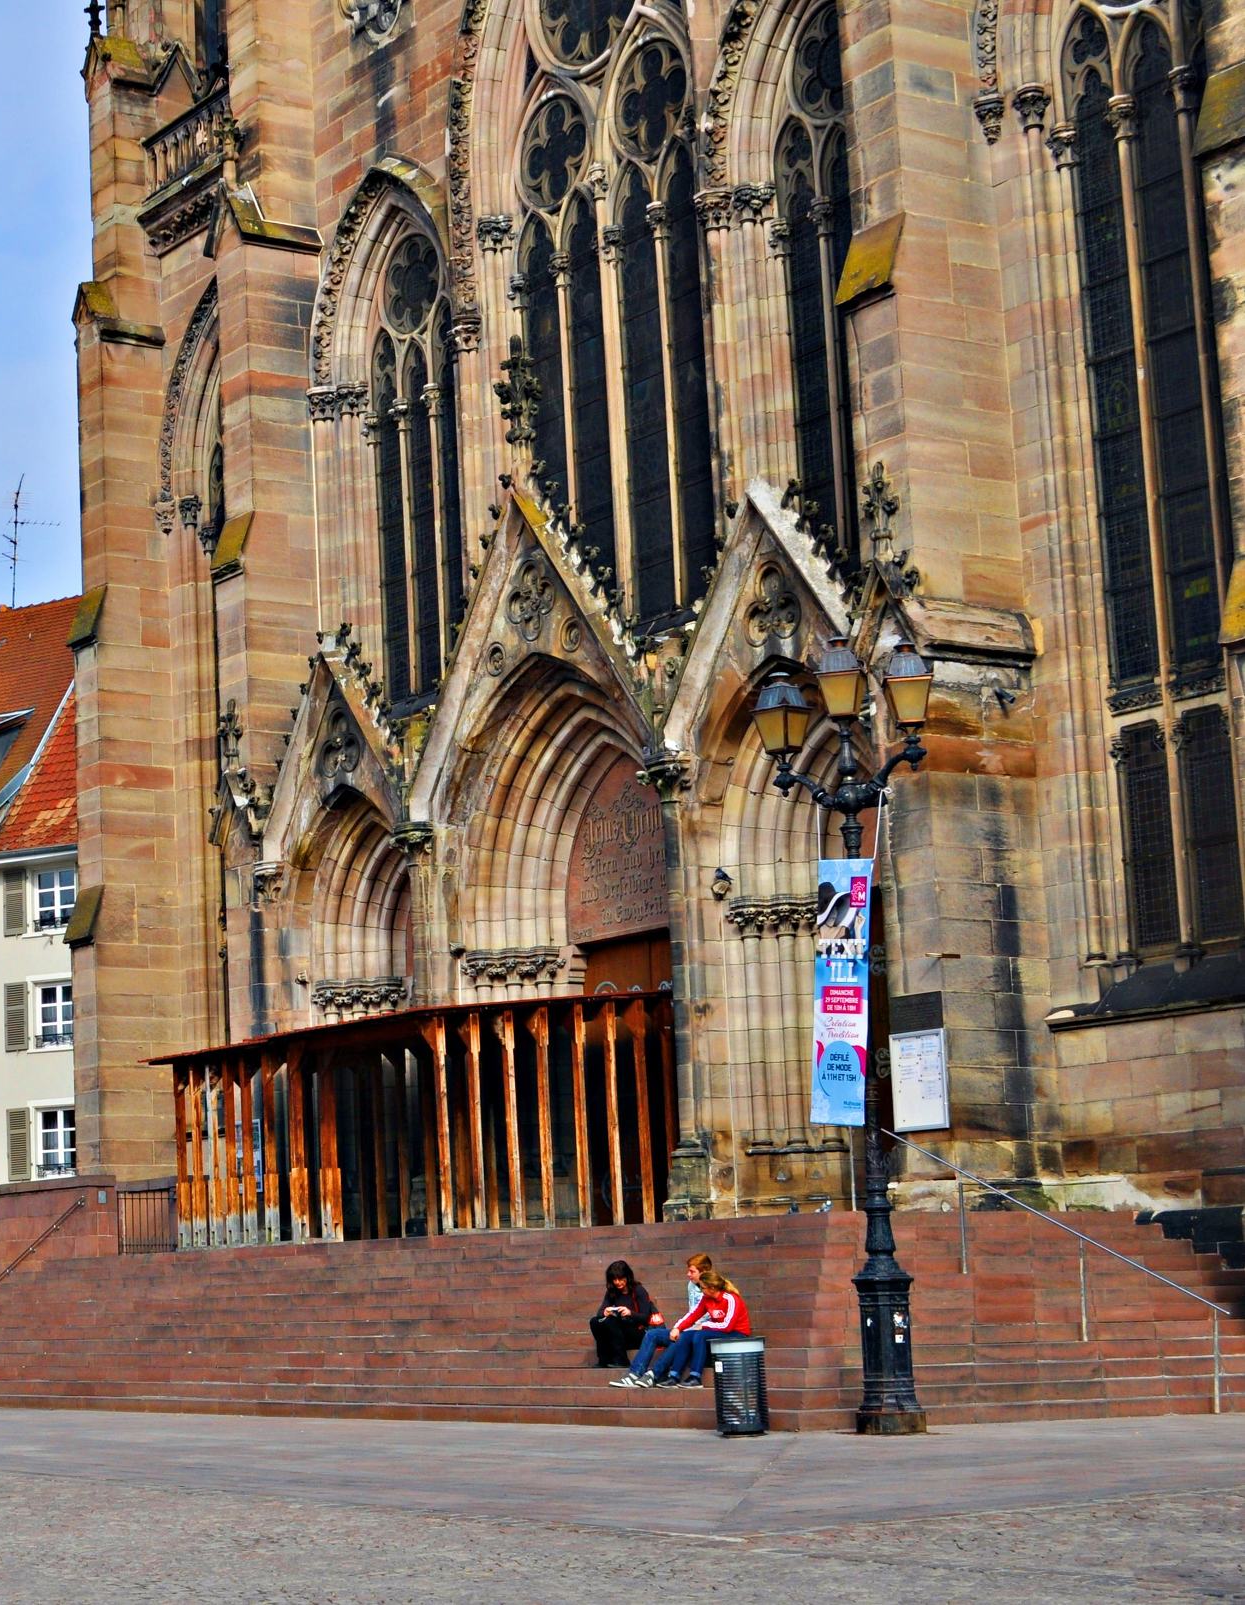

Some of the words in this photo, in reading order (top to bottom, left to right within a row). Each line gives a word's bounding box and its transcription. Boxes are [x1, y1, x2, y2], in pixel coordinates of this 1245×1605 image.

[818, 938, 867, 959] TEXT
[830, 1052, 849, 1061] DÉFILÉ
[827, 1063, 834, 1071] DE
[835, 1064, 852, 1072] MODE
